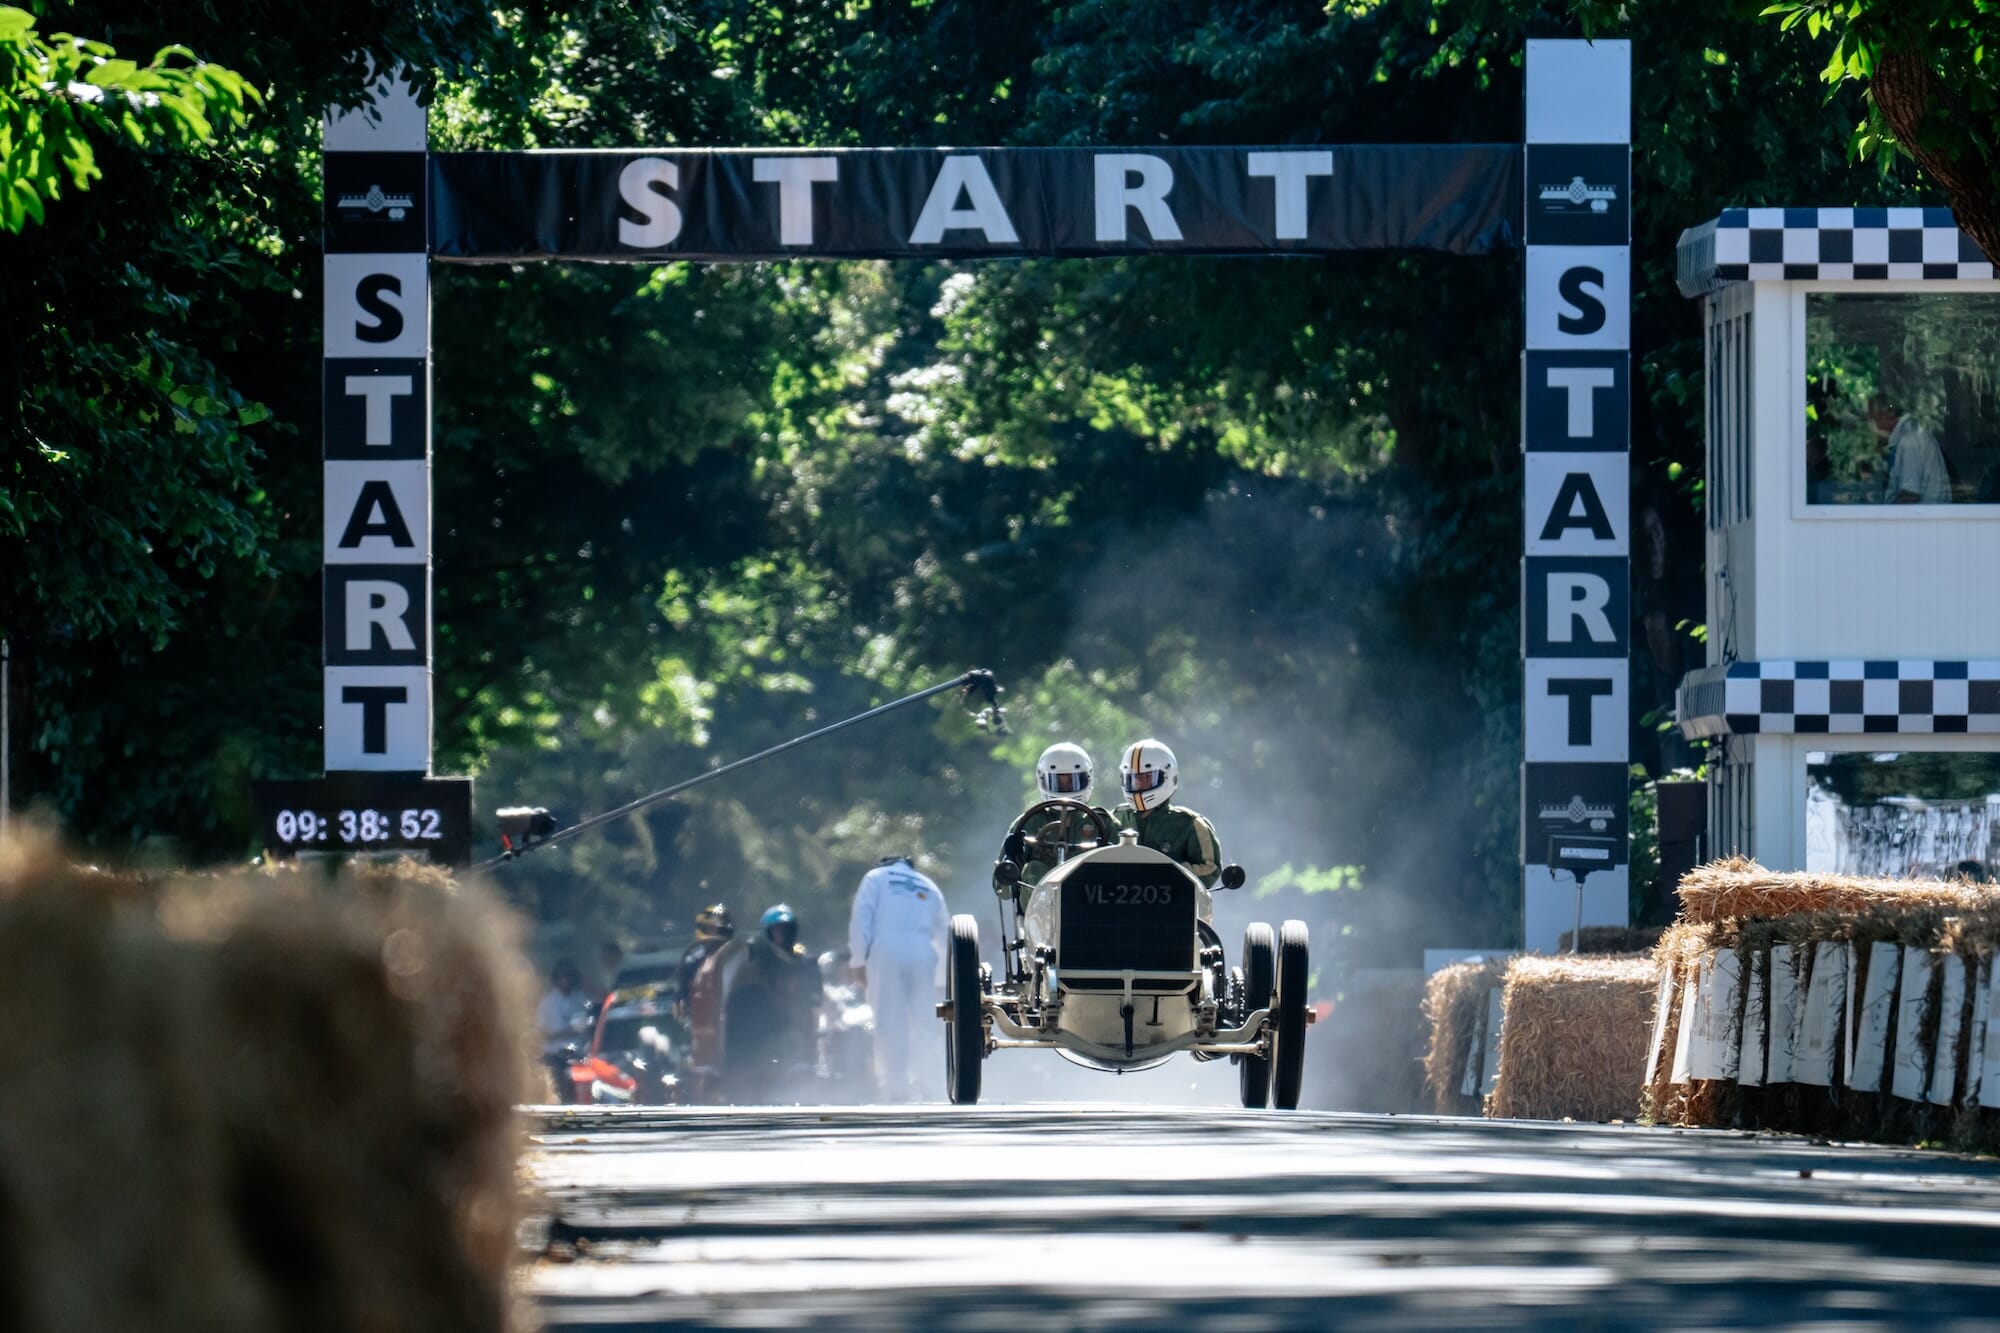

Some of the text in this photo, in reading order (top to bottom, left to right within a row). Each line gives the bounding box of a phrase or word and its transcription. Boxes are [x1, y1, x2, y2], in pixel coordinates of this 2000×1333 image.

[618, 151, 1334, 248] START
[338, 273, 417, 755] START
[1539, 265, 1617, 747] START
[1084, 884, 1172, 904] VL-2203
